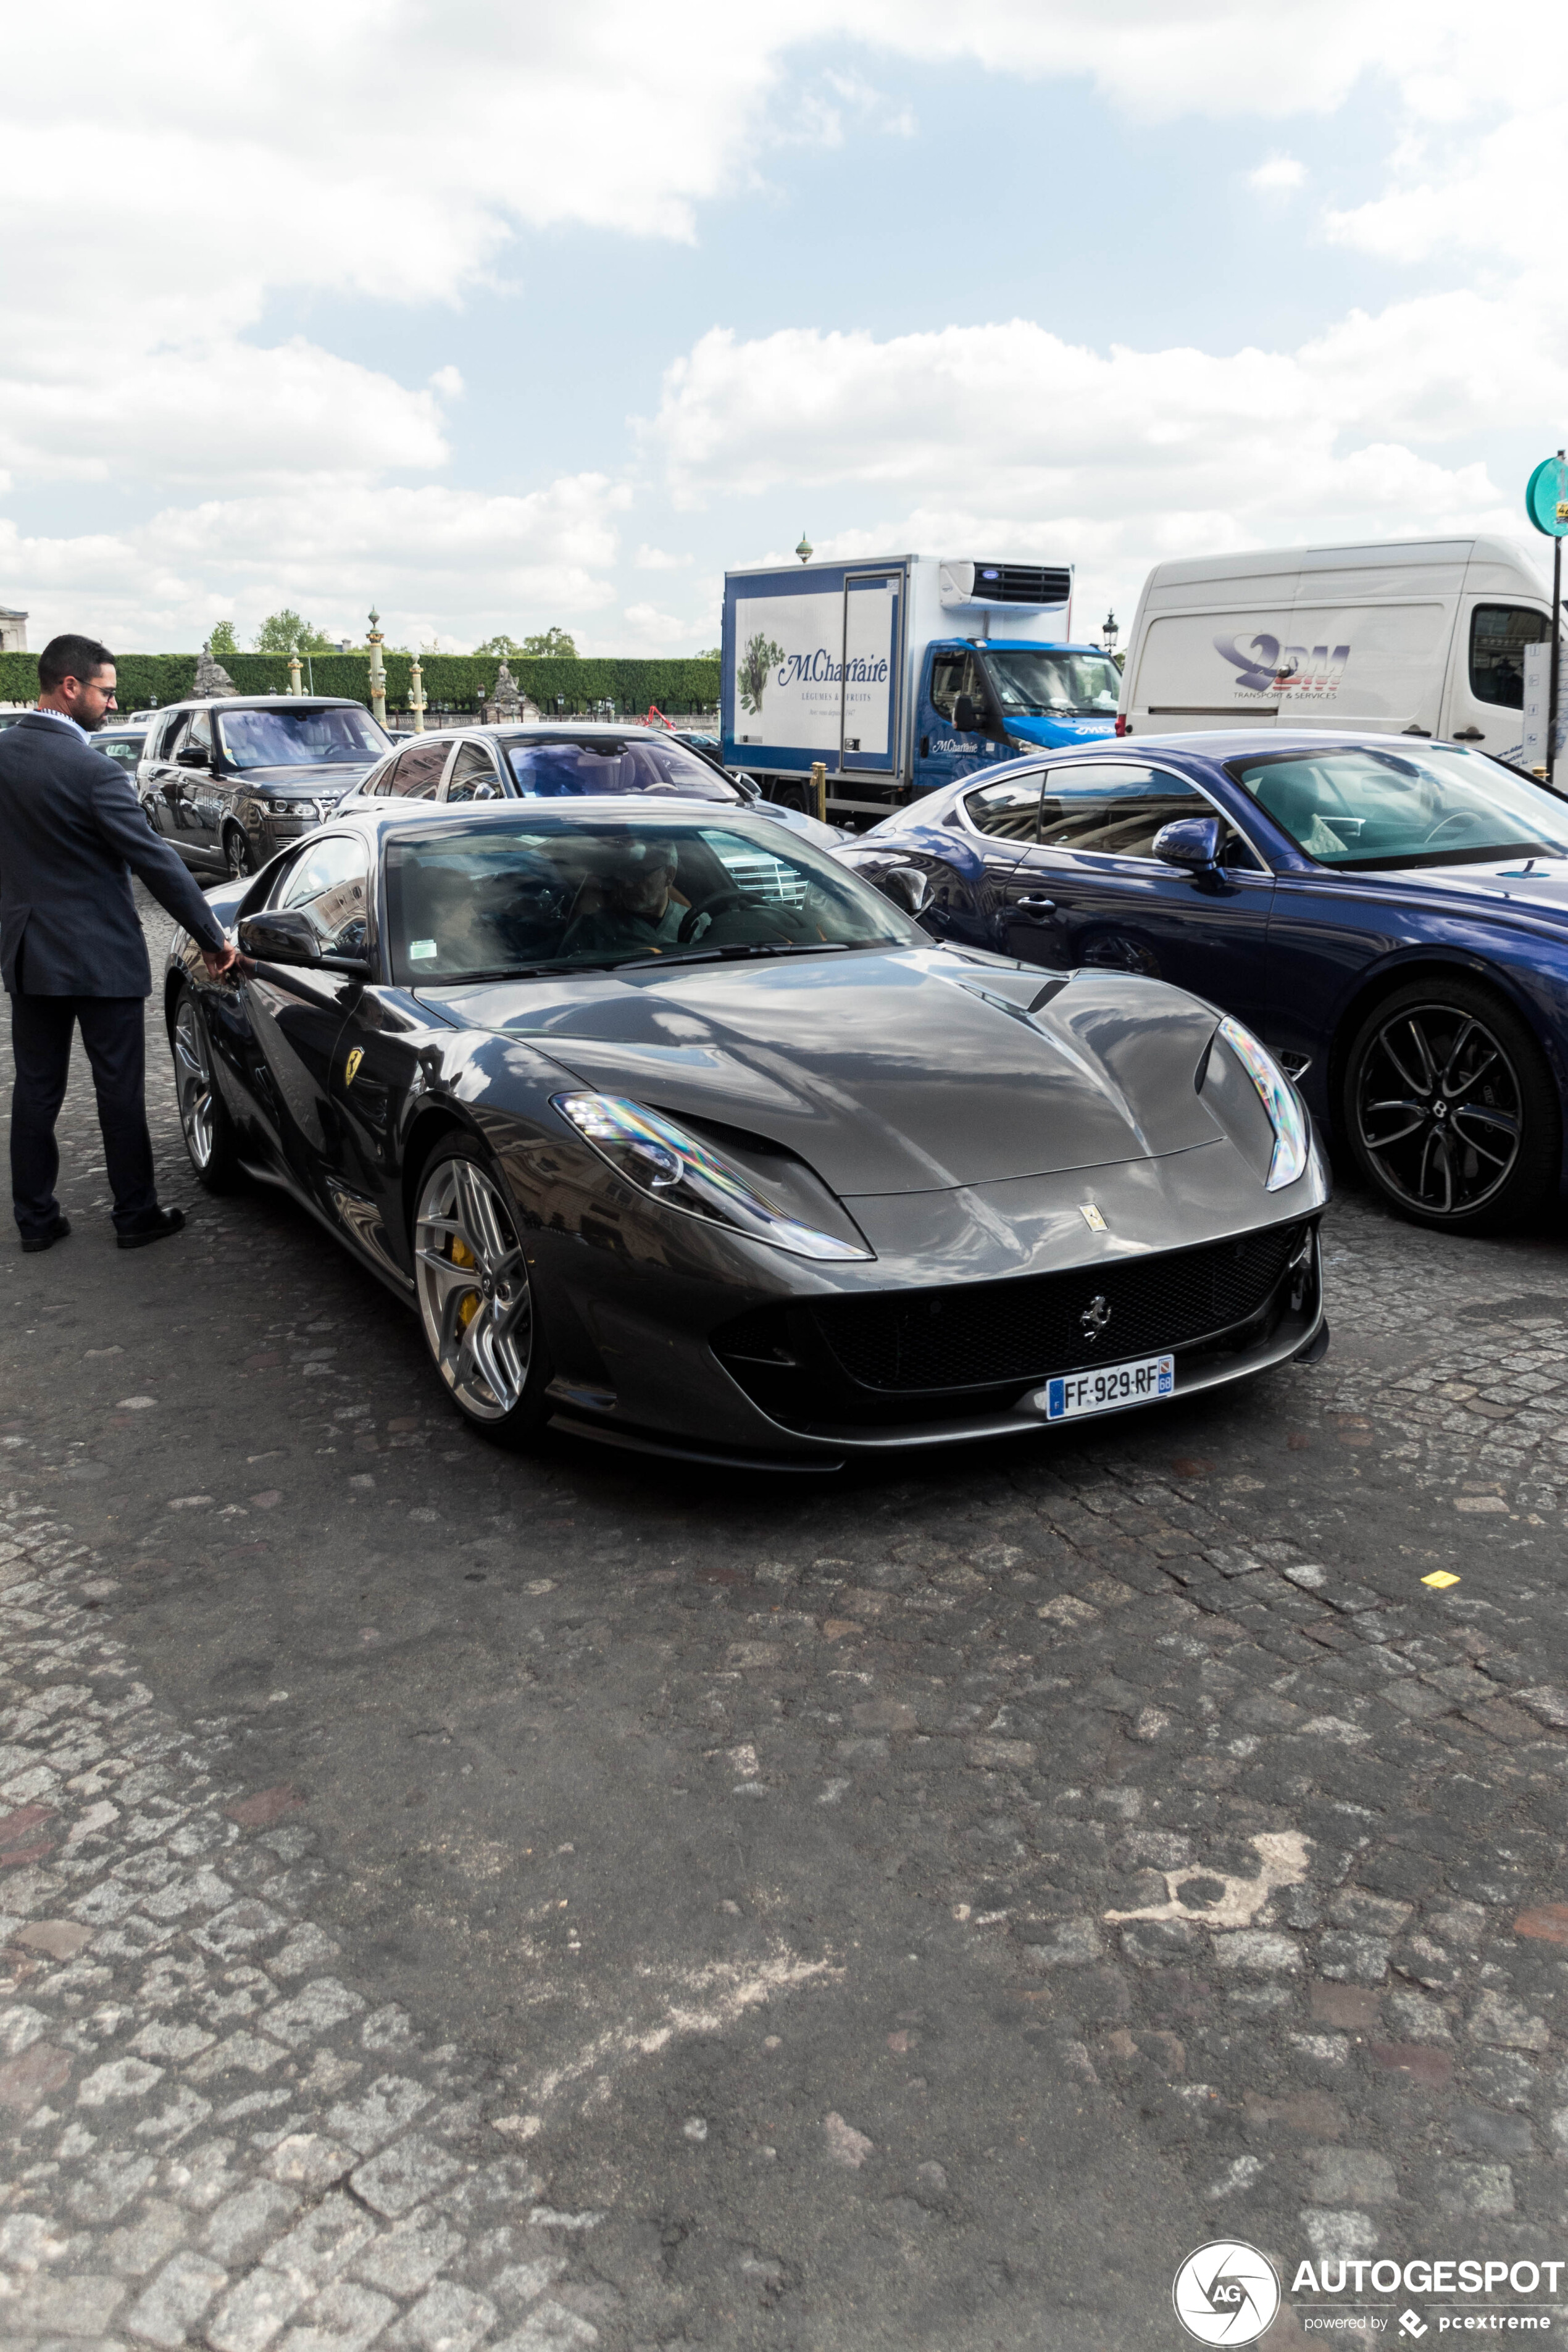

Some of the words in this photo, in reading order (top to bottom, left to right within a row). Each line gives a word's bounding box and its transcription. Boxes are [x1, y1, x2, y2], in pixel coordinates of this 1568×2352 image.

[846, 693, 871, 701] FRUITS
[1065, 1365, 1157, 1409] FF-929-RF
[1160, 1376, 1172, 1391] 68
